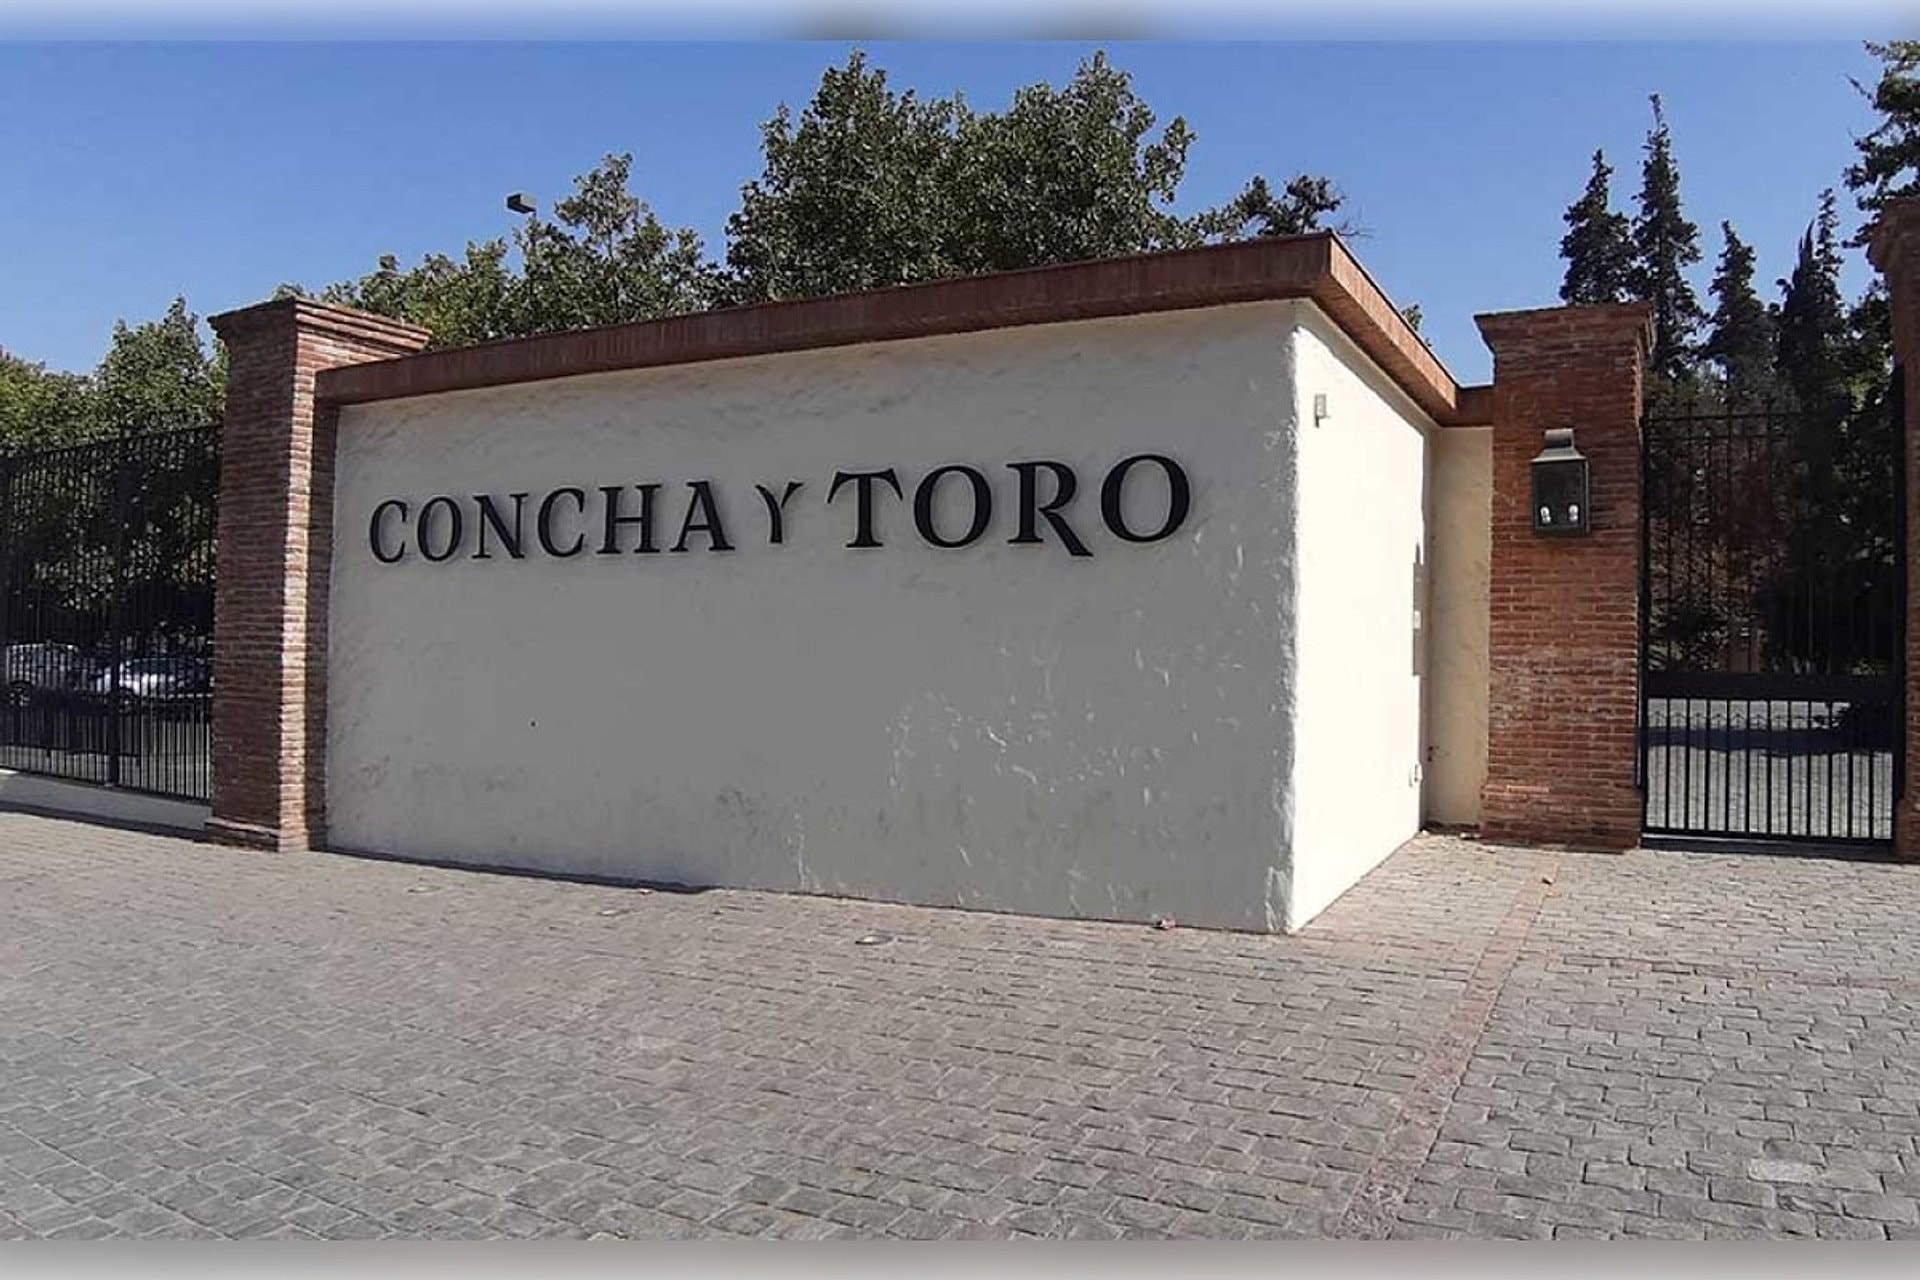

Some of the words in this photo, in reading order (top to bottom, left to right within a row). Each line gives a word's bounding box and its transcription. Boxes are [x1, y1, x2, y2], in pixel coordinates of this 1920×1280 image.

[368, 480, 735, 563] CONCHA
[755, 481, 804, 545] Y
[827, 454, 1191, 557] TORO
